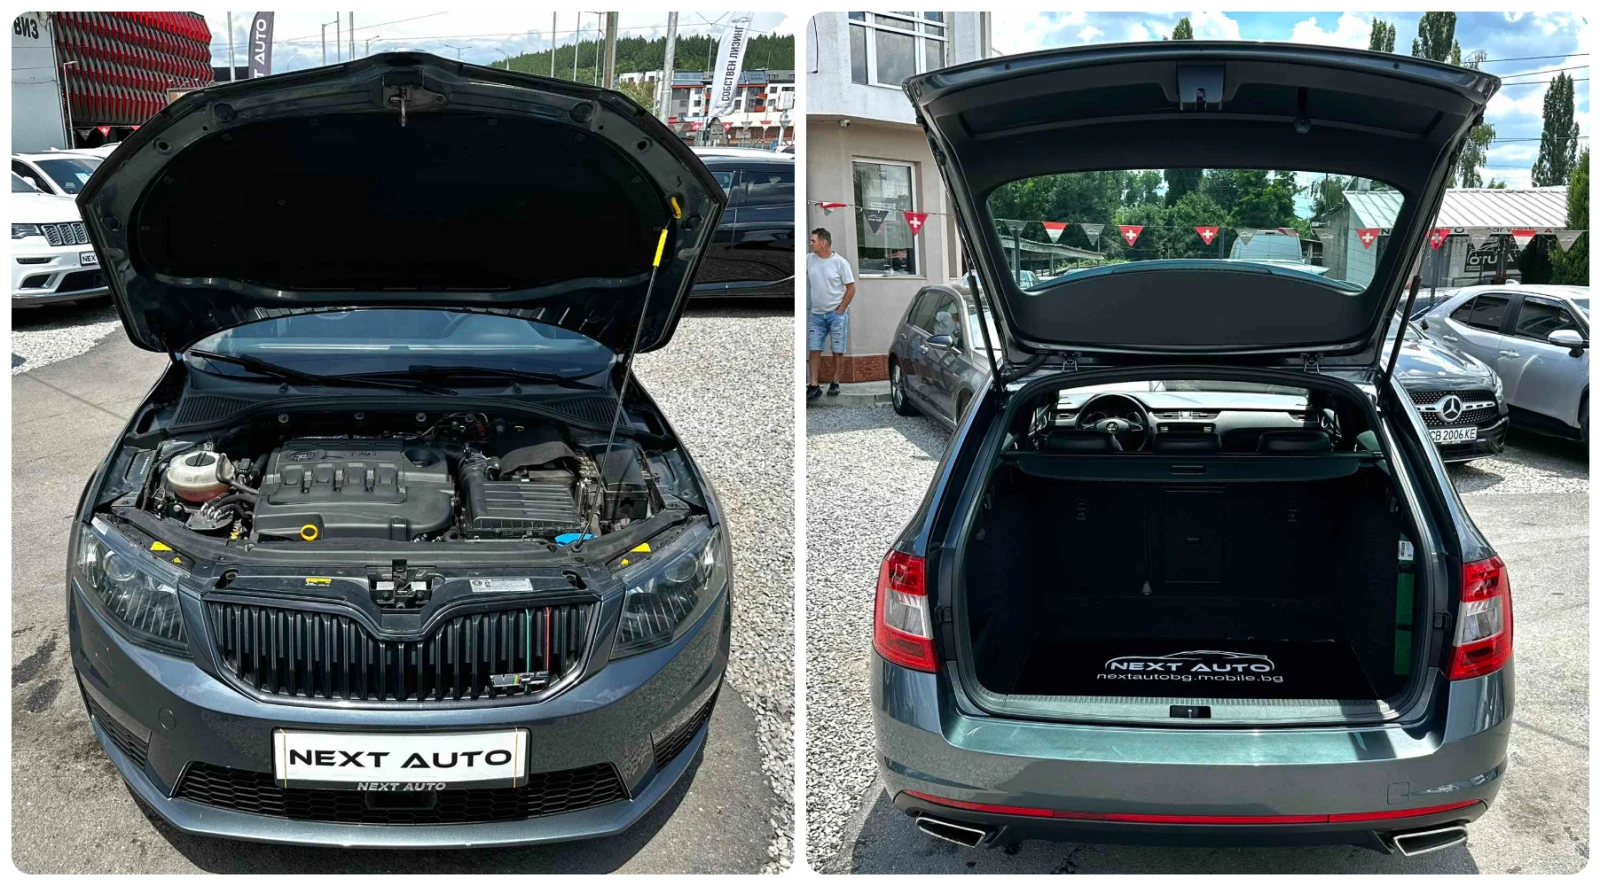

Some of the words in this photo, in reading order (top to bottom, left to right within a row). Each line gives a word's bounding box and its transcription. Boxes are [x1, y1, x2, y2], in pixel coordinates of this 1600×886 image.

[254, 18, 267, 66] AUTO
[721, 60, 737, 102] СОБСТВЕН
[729, 25, 745, 59] ЛИЗИНГ
[1443, 429, 1464, 440] 2006
[1464, 428, 1476, 439] KE
[1110, 661, 1184, 672] NEXT
[1190, 662, 1271, 673] AUTO
[1096, 672, 1284, 683] nextautobg.mobile.bg
[289, 749, 391, 768] NEXT
[400, 749, 512, 769] AUTO
[357, 782, 400, 791] NEXT
[405, 782, 447, 791] AUTO
